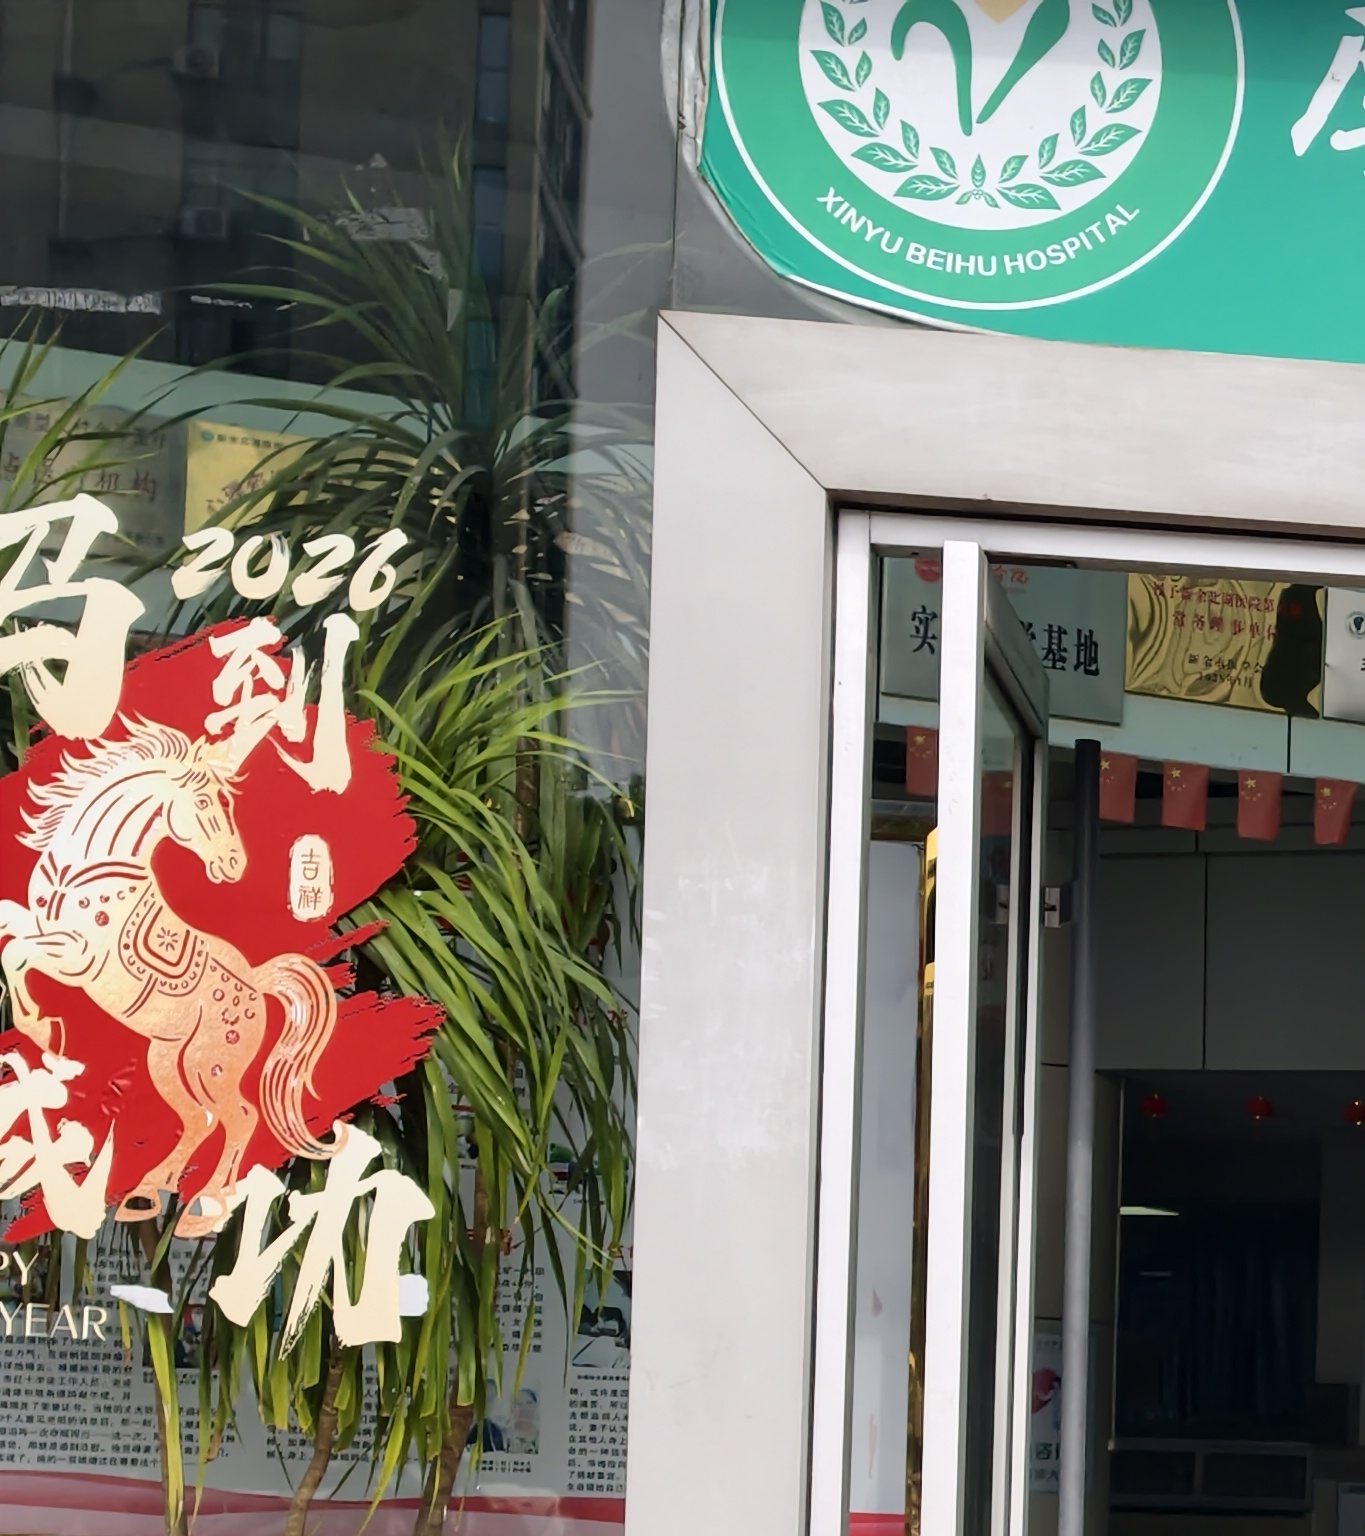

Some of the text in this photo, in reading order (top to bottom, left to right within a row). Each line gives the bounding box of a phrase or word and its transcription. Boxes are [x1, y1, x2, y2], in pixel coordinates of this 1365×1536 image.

[815, 186, 1142, 277] XINYU BEIHU HOSPITAL
[171, 527, 409, 611] 2026
[204, 613, 360, 796] 到
[297, 847, 325, 911] 吉祥
[209, 1120, 437, 1361] 功
[0, 1303, 108, 1342] YEAR
